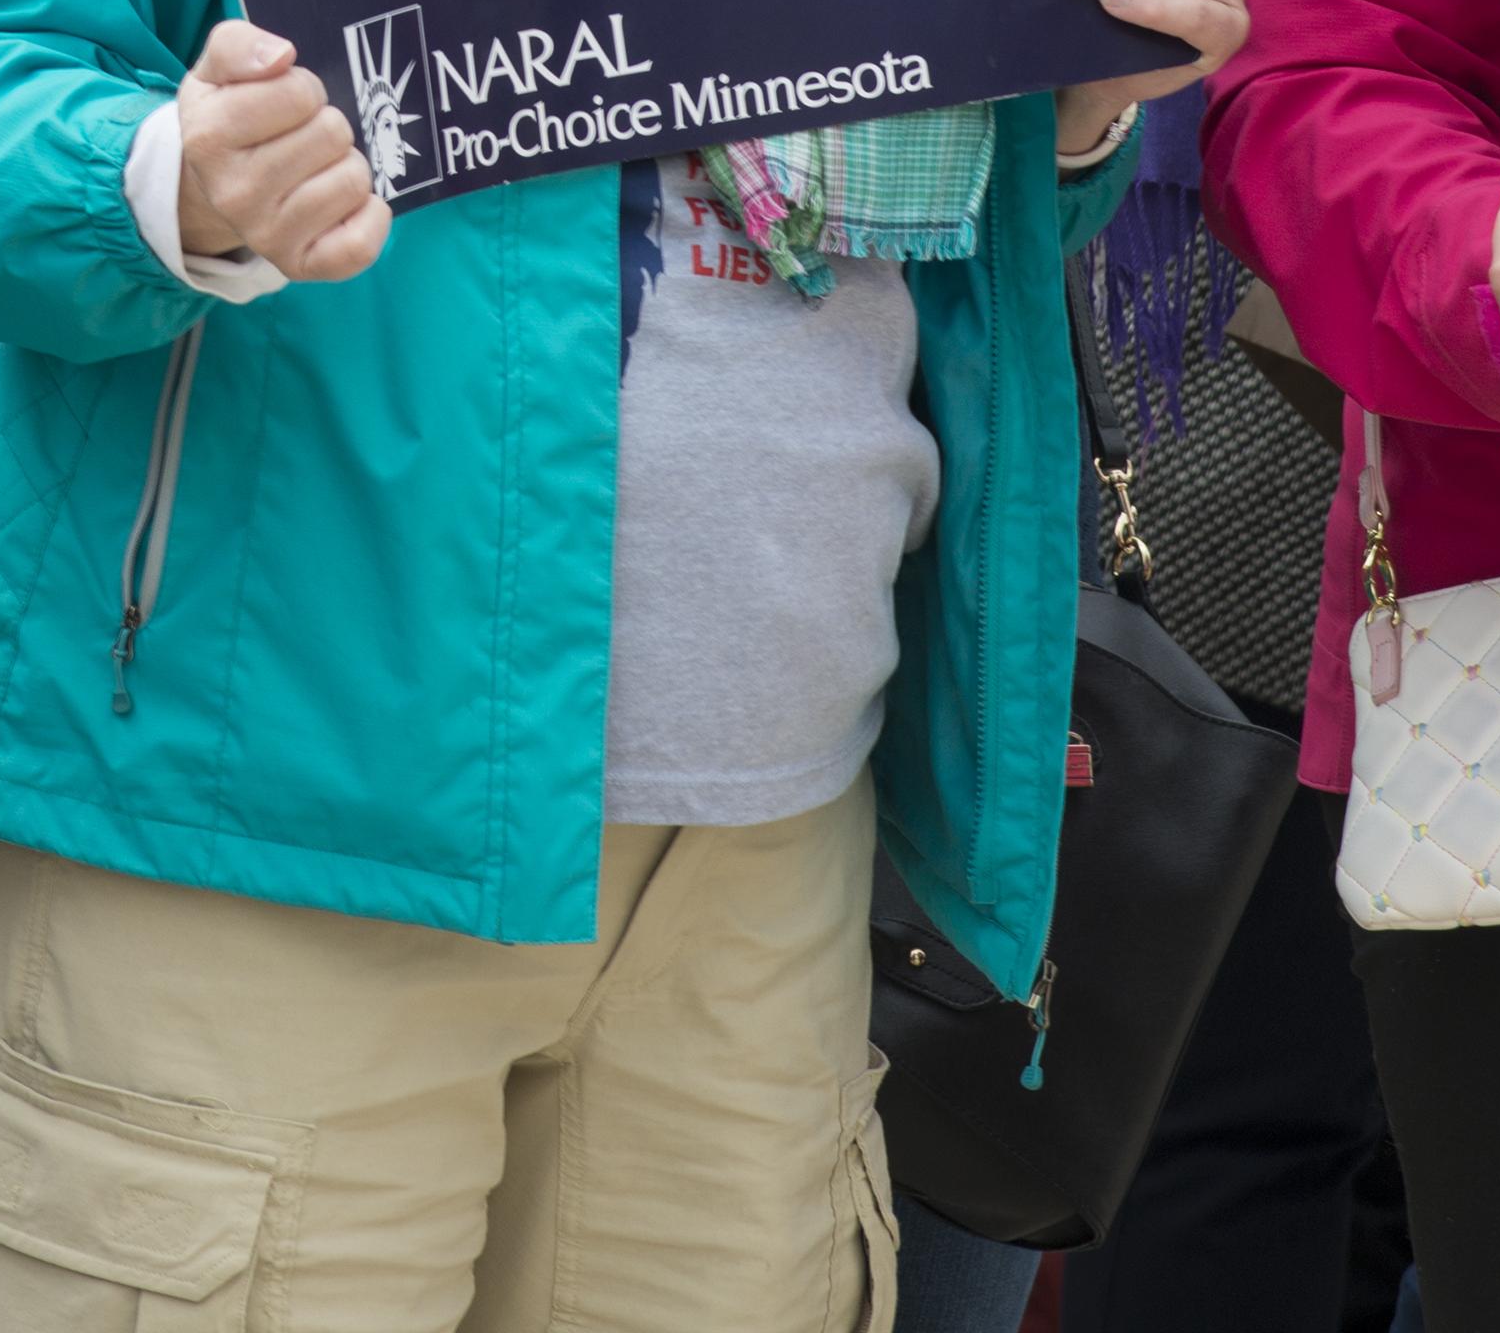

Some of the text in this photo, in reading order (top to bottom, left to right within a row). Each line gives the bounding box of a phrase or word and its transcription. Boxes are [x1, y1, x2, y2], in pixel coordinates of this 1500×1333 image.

[432, 12, 654, 114] NARAL
[441, 50, 934, 177] Pro-Choice Minnesota
[691, 243, 772, 285] LIES
